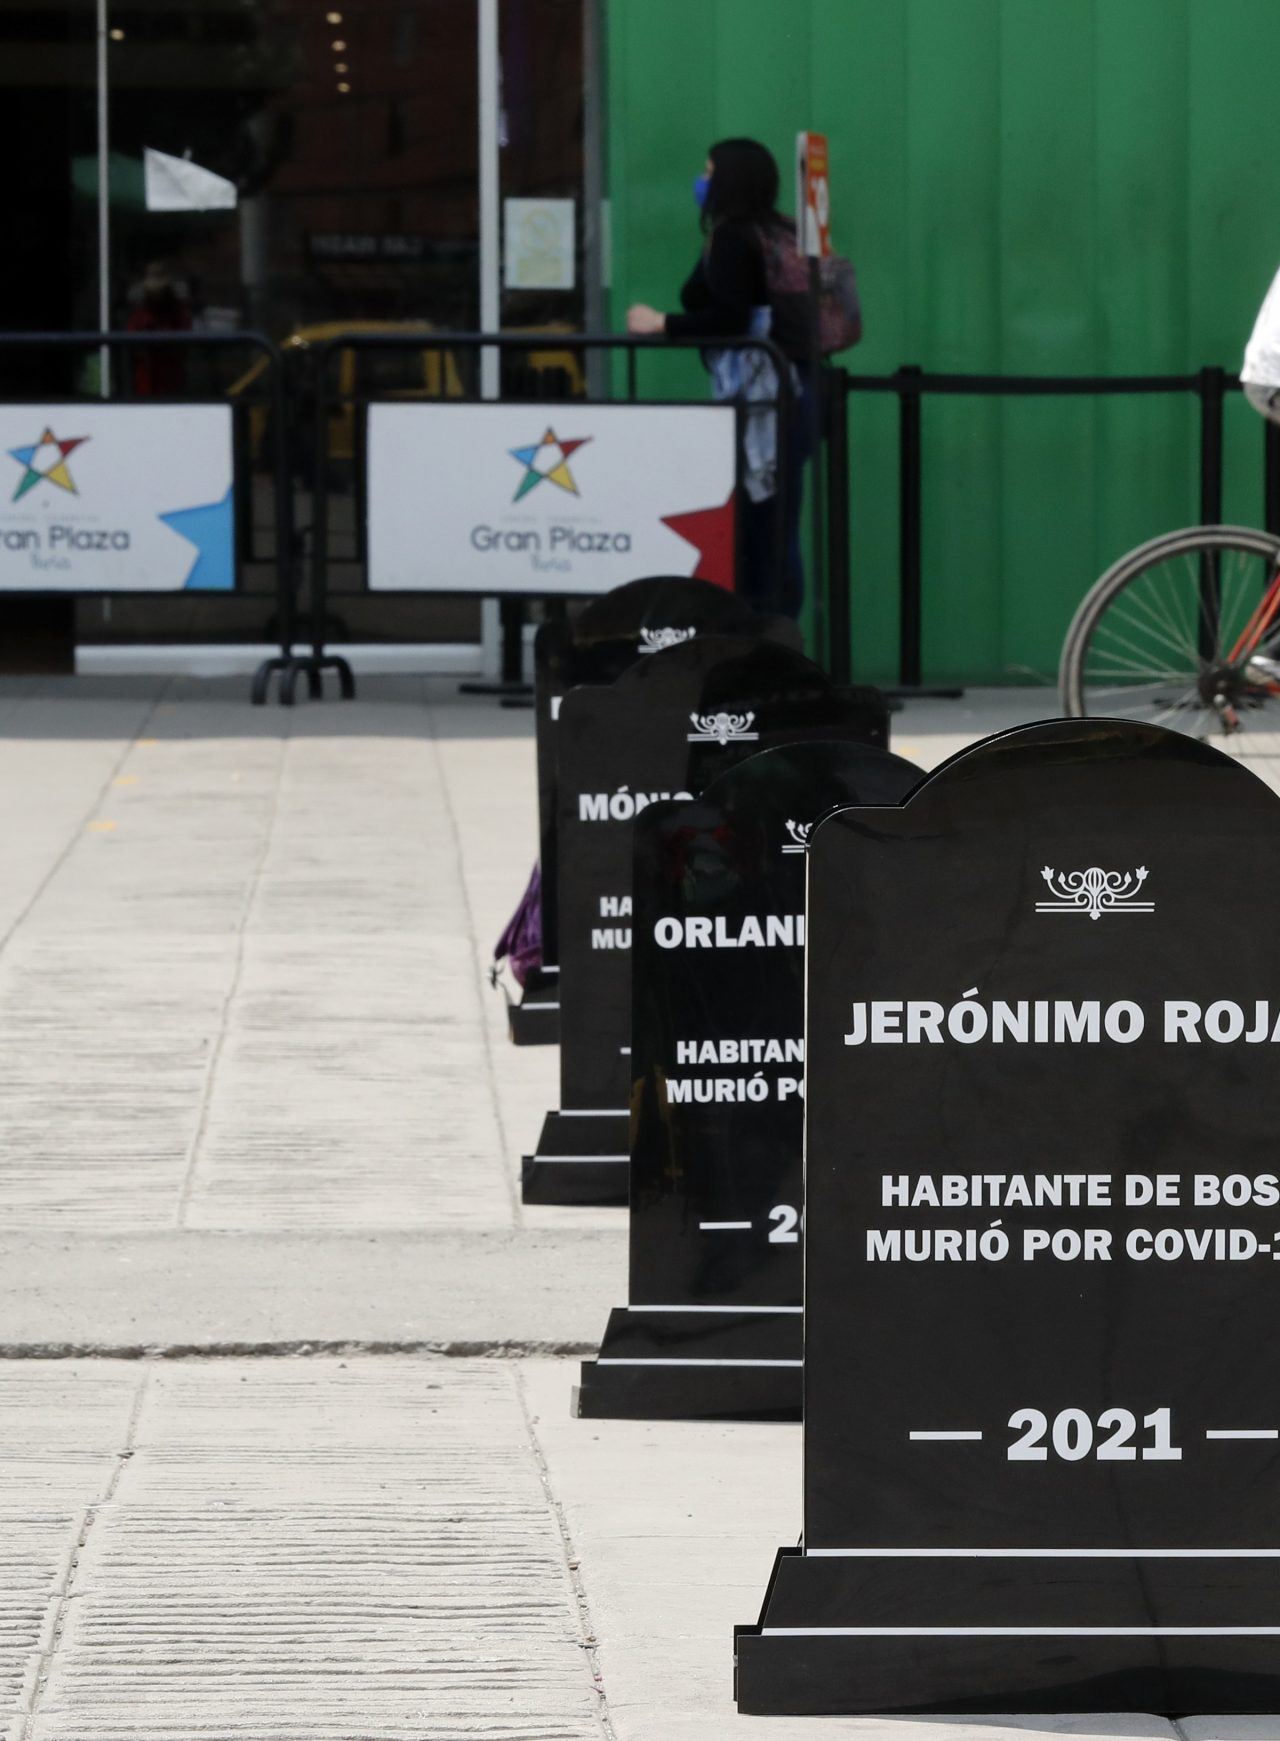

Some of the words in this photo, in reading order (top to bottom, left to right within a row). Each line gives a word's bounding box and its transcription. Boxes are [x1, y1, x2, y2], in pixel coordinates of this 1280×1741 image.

[49, 525, 130, 551] Plaza
[471, 526, 540, 551] Gran
[550, 526, 631, 552] Plaza
[655, 915, 804, 948] ORLAN
[844, 987, 1144, 1045] JERÓNIMO
[667, 1071, 768, 1103] MURIÓ
[882, 1175, 1111, 1206] HABITANTE
[1126, 1175, 1180, 1205] DE
[769, 1205, 804, 1243] 2
[867, 1219, 1009, 1261] MURIÓ
[1024, 1229, 1112, 1260] POR
[1008, 1408, 1182, 1461] 2021
